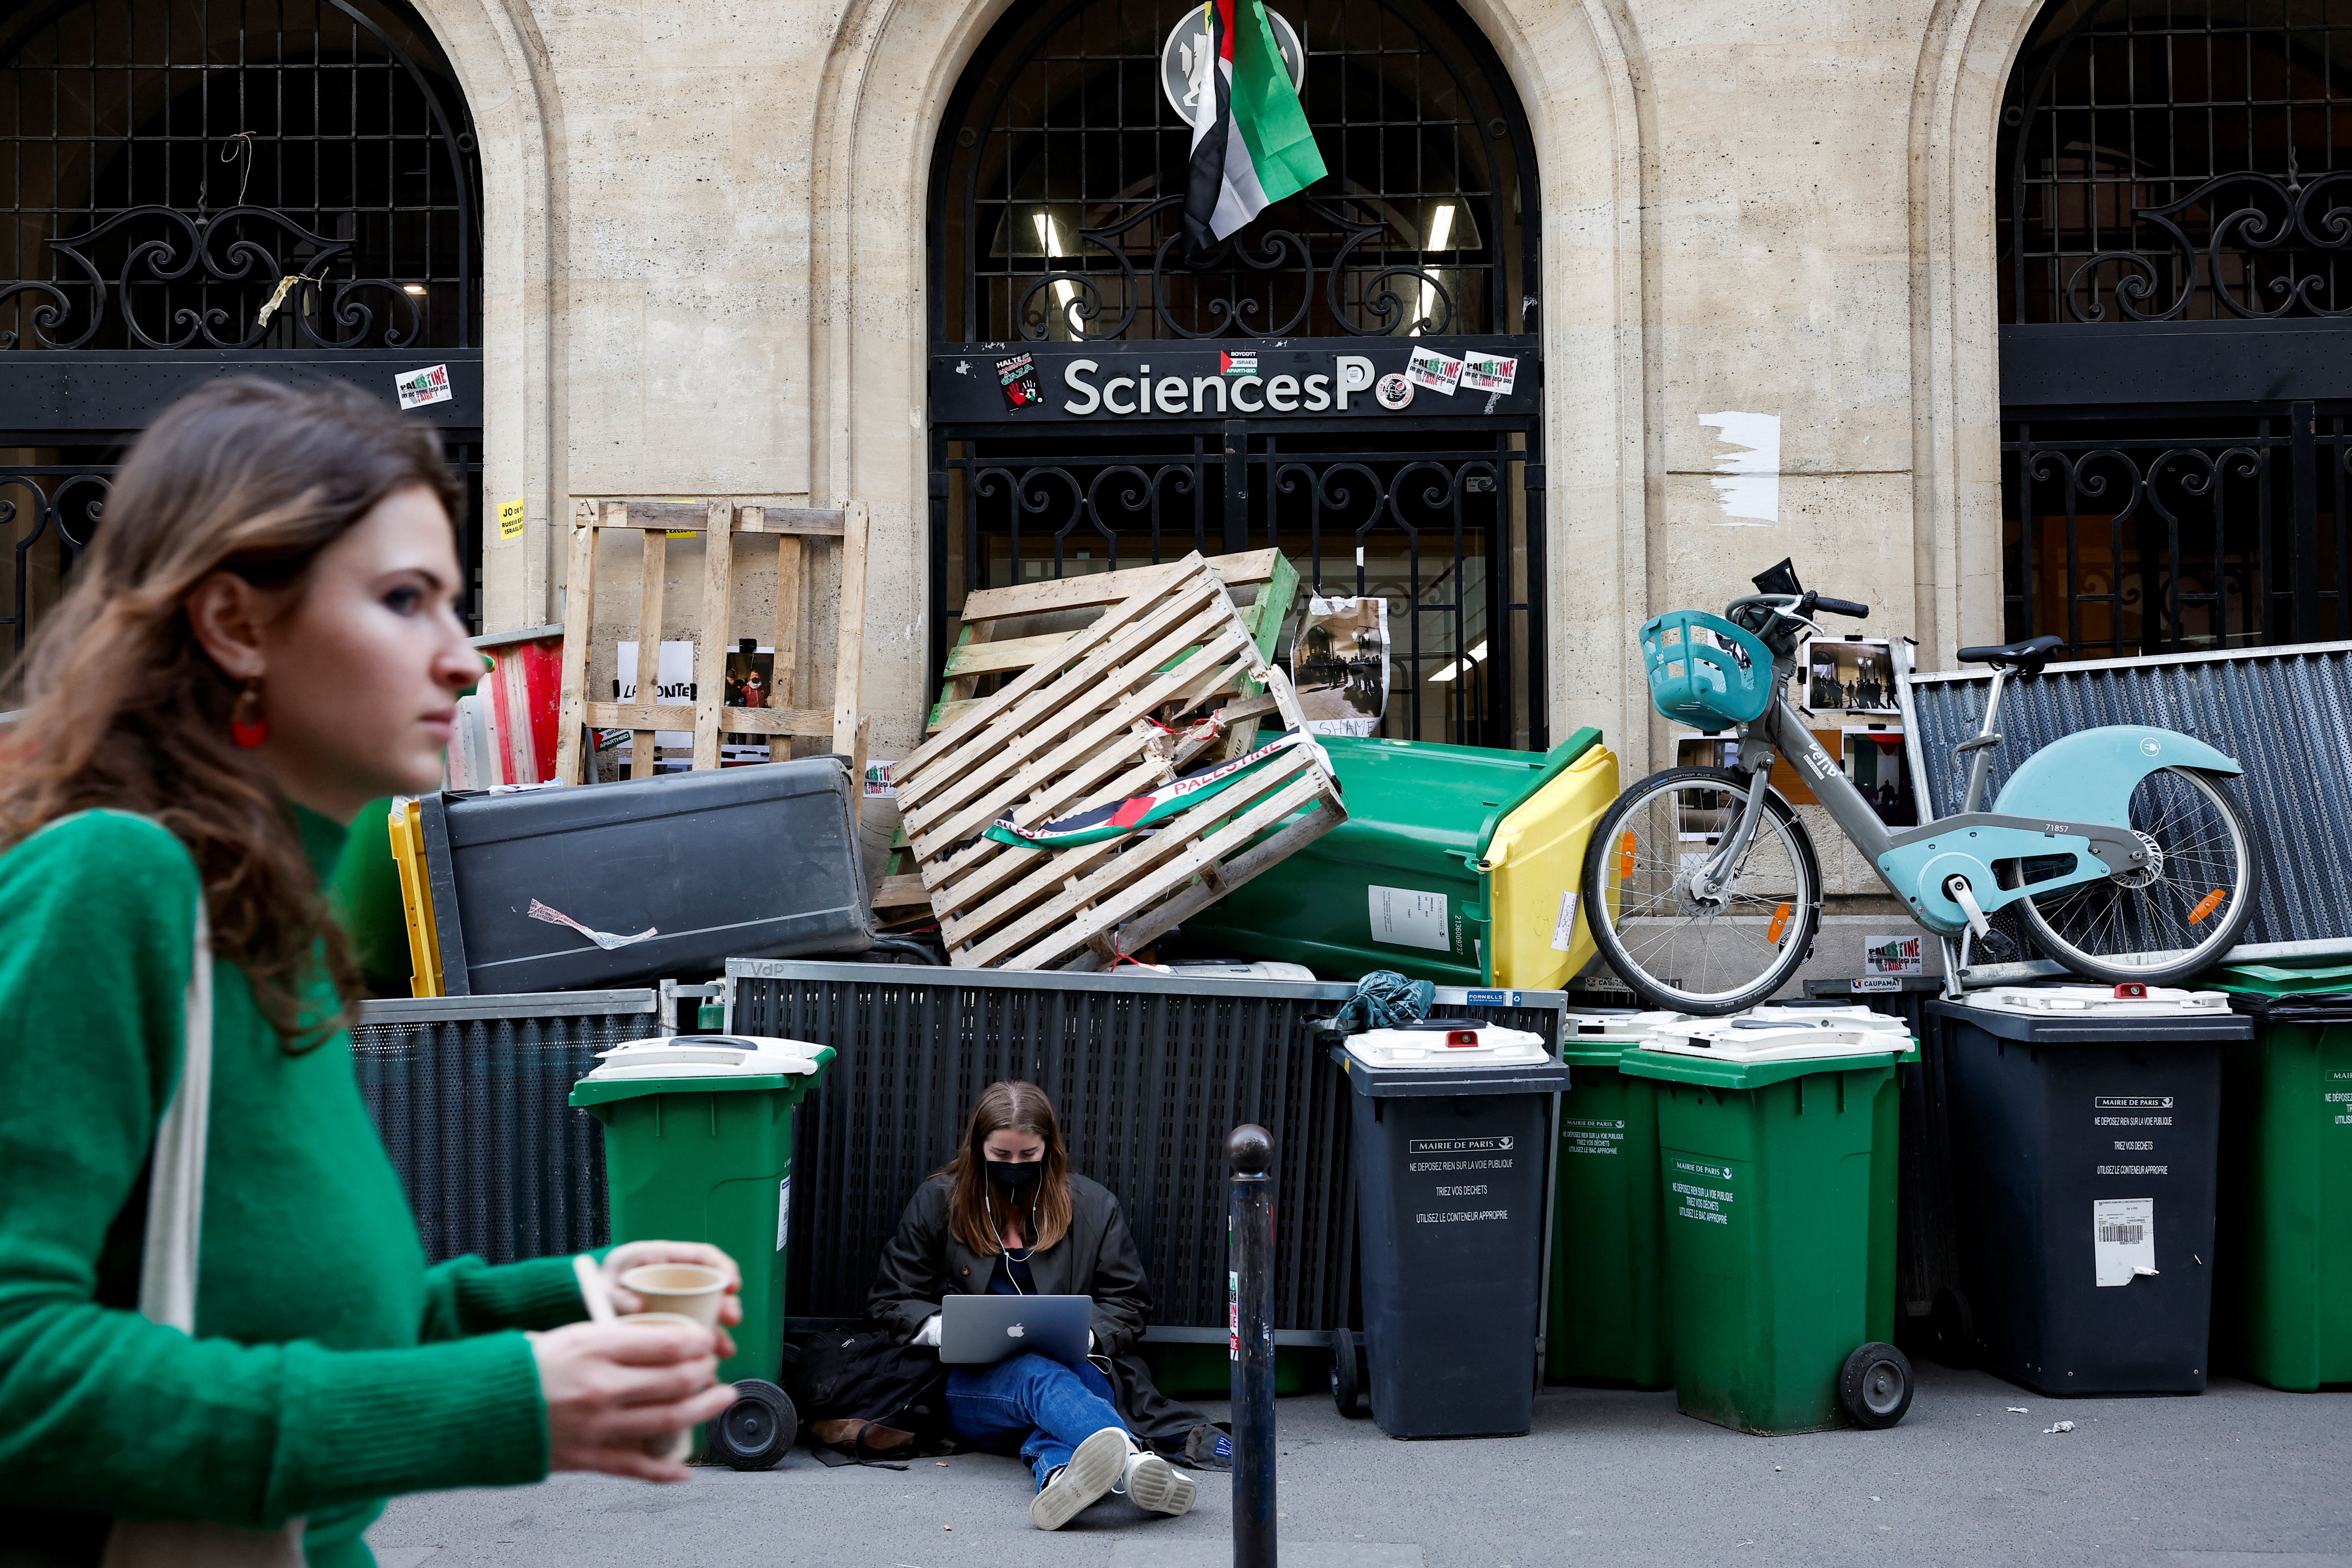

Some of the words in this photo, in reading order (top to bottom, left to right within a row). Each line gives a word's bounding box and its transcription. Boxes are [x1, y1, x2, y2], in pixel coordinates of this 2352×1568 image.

[996, 356, 1022, 368] HALTE
[998, 357, 1032, 375] MASSACRE
[1413, 357, 1460, 378] PALESTINE
[1467, 360, 1514, 377] PALESTINE
[400, 366, 446, 390] PALESTINE
[1001, 364, 1034, 385] GAZA
[1382, 375, 1405, 383] ANTIFASCISTE
[1424, 369, 1436, 378] nous
[1064, 355, 1415, 415] SciencesP
[1421, 375, 1438, 386] TAIRE
[1478, 378, 1495, 387] TAIRE
[416, 391, 434, 402] TAIRE
[1402, 389, 1411, 403] BANLIEUE
[503, 508, 512, 517] JO
[502, 520, 517, 528] RUSSIE
[1320, 720, 1374, 735] SHAME
[600, 733, 629, 748] APARTHEID
[1174, 741, 1282, 794] PALESTINE
[868, 785, 882, 794] TAIRE
[1625, 787, 1649, 806] SCHWALBE
[2046, 824, 2069, 833] 71857
[1455, 915, 1463, 956] 2136009737
[1868, 937, 1920, 957] PALESTINE
[751, 963, 784, 976] VdP
[1884, 962, 1903, 972] TAIRE
[2325, 1093, 2331, 1102] NE
[2095, 1117, 2101, 1125] NE
[2101, 1117, 2120, 1125] DEPOSEZ
[2120, 1117, 2130, 1125] RIEN
[2130, 1117, 2138, 1125] SUR
[2139, 1117, 2144, 1125] LA
[2144, 1117, 2153, 1125] VOIE
[2154, 1117, 2172, 1125] PUBLIQUE
[2114, 1141, 2125, 1150] TRIEZ
[2126, 1141, 2134, 1150] VOS
[2134, 1141, 2153, 1150] DECHETS
[1409, 1163, 1417, 1172] NE
[1418, 1162, 1442, 1171] DEPOSEZ
[1443, 1161, 1455, 1170] RIEN
[1456, 1161, 1467, 1169] SUR
[1468, 1161, 1474, 1169] LA
[1475, 1160, 1487, 1169] VOIE
[1488, 1159, 1513, 1168] PUBLIQUE
[1677, 1162, 1695, 1171] MAIRIE
[1705, 1167, 1720, 1175] PARIS
[2097, 1166, 2115, 1174] UTILISEZ
[2115, 1166, 2120, 1174] LE
[2120, 1166, 2145, 1174] CONTENEUR
[2145, 1166, 2168, 1175] APPROPRIE
[1436, 1187, 1451, 1196] TRIEZ
[1451, 1186, 1463, 1195] VOS
[1463, 1185, 1487, 1195] DECHETS
[1672, 1182, 1677, 1192] NE
[1677, 1181, 1690, 1194] DÉPOSEZ
[1705, 1188, 1709, 1197] LA
[1717, 1191, 1733, 1202] PUBLIQUE
[1686, 1196, 1695, 1207] TRIEZ
[1703, 1198, 1719, 1211] DÉCHETS
[1416, 1213, 1439, 1223] UTILISEZ
[1439, 1213, 1446, 1222] LE
[1447, 1211, 1478, 1222] CONTENEUR
[1479, 1210, 1508, 1220] APPROPRIE
[1679, 1206, 1693, 1218] UTILISEZ
[1694, 1209, 1698, 1219] LE
[1707, 1214, 1727, 1225] APPROPRIÉ
